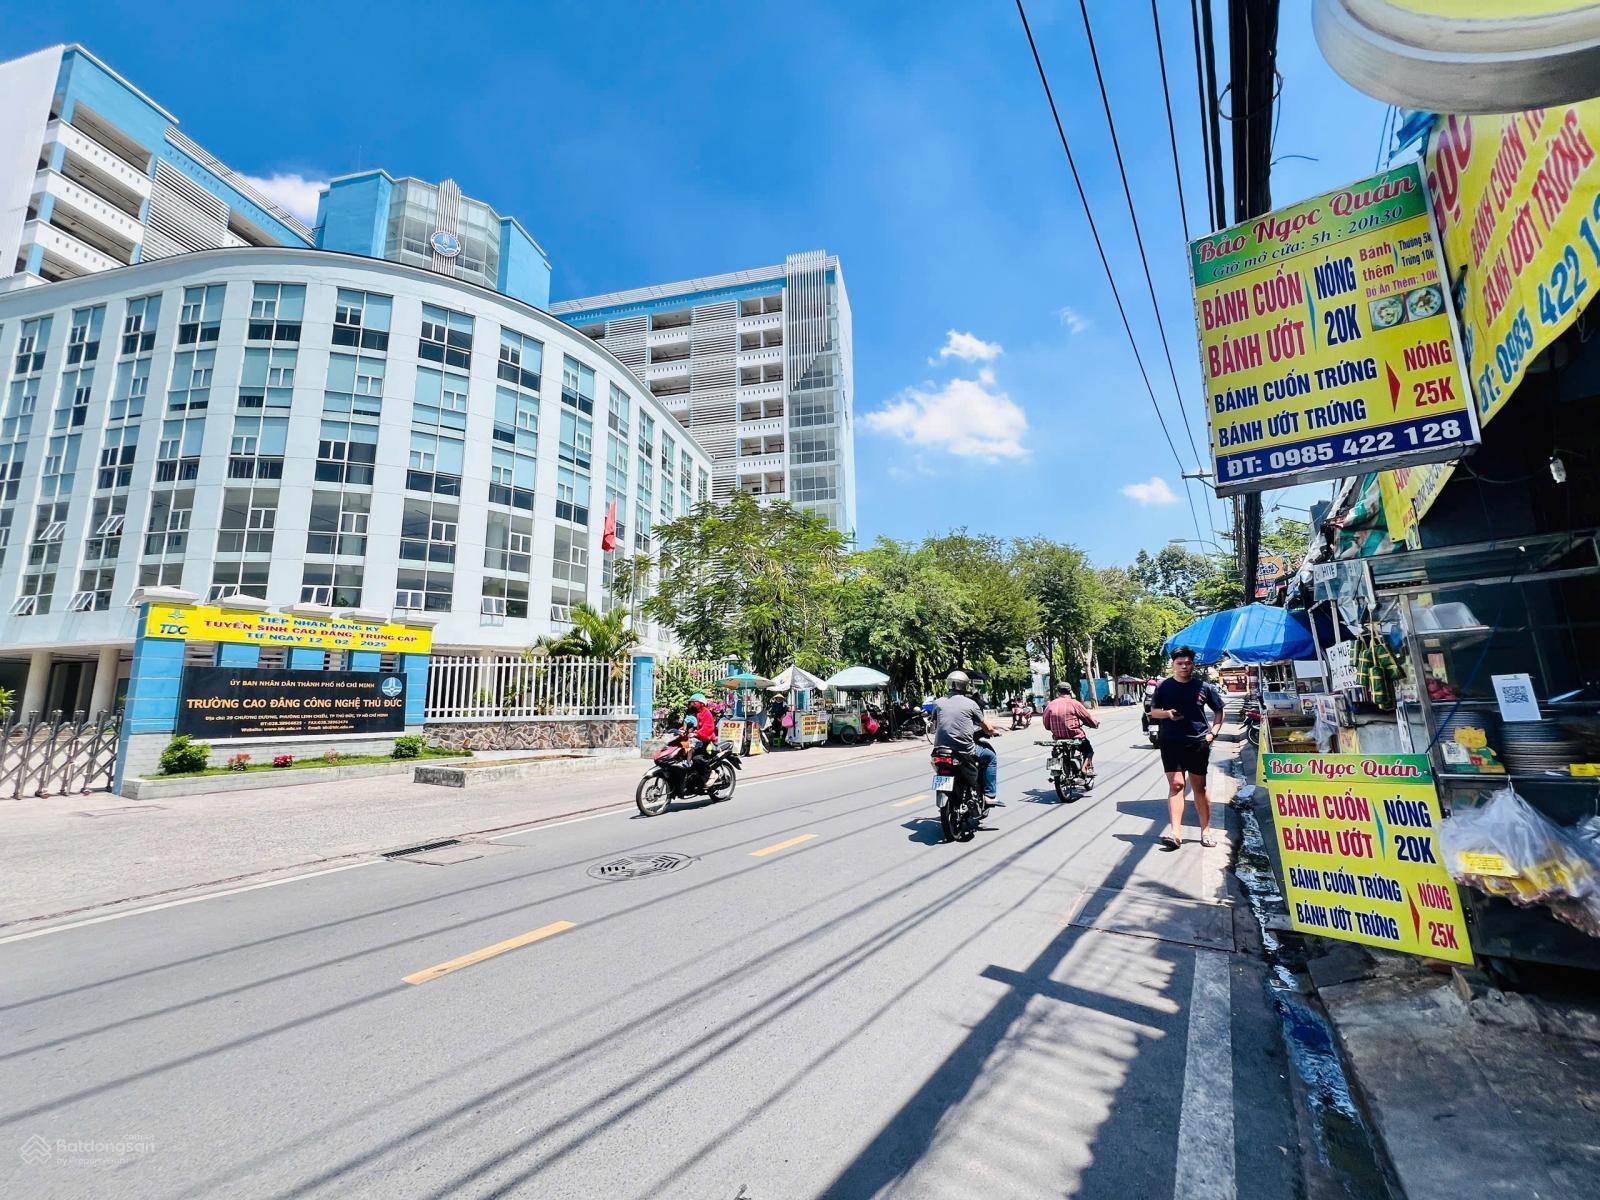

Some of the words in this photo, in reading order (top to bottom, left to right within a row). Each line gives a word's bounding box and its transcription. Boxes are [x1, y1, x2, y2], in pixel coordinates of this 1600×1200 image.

[1196, 235, 1247, 263] Bảo
[1252, 208, 1323, 245] Ngọc
[1329, 176, 1418, 216] Quán
[1211, 260, 1240, 277] Giờ
[1243, 251, 1268, 269] mở
[1271, 241, 1305, 260] cửa:
[1311, 231, 1331, 247] 5h
[1348, 206, 1403, 234] 20h30
[1359, 241, 1392, 262] Bánh
[1313, 255, 1357, 300] NÓNG
[1362, 263, 1394, 282] thêm
[1201, 288, 1250, 331] BÁNH
[1252, 263, 1303, 316] CUỐN
[1495, 306, 1534, 384] 0985
[1538, 245, 1587, 325] 422
[1324, 303, 1362, 346] 20K
[1207, 334, 1263, 378] BÁNH
[1266, 317, 1305, 363] ƯỚT
[1403, 340, 1453, 372] NÓNG
[1214, 387, 1259, 414] BÁNH
[1262, 368, 1311, 403] CUỐN
[1314, 357, 1378, 391] TRỨNG
[1413, 376, 1456, 407] 25K
[1218, 421, 1264, 448] BÁNH
[1267, 410, 1299, 438] ƯỚT
[1303, 398, 1367, 430] TRỨNG
[1226, 456, 1263, 477] ĐT:
[1269, 442, 1334, 470] 0985
[1342, 431, 1396, 456] 422
[1403, 419, 1461, 446] 128
[160, 624, 188, 634] TDC
[257, 624, 288, 633] SINH
[292, 627, 316, 635] CAO
[359, 632, 394, 641] TRUNG
[186, 696, 240, 709] TRƯỜNG
[242, 699, 267, 708] CAO
[269, 696, 301, 708] ĐẲNG
[303, 697, 332, 708] CÔNG
[334, 697, 361, 709] NGHỆ
[362, 697, 381, 707] THỦ
[383, 696, 402, 707] ĐỨC
[1308, 759, 1356, 779] Ngọc
[1361, 759, 1420, 778] Quán
[1276, 789, 1320, 818] BÁNH
[1322, 788, 1371, 822] CUỐN
[1383, 795, 1432, 828] NÓNG
[1281, 823, 1333, 854] BÁNH
[1336, 827, 1373, 859] ƯỚT
[1394, 835, 1437, 865] 20K
[1289, 864, 1321, 890] BÁNH
[1322, 866, 1357, 896] CUỐN
[1357, 873, 1402, 902] TRỨNG
[1417, 879, 1453, 911] NÓNG
[1295, 900, 1329, 928] BÁNH
[1329, 905, 1353, 932] ƯỚT
[1355, 910, 1400, 941] TRỨNG
[1428, 921, 1460, 950] 25K
